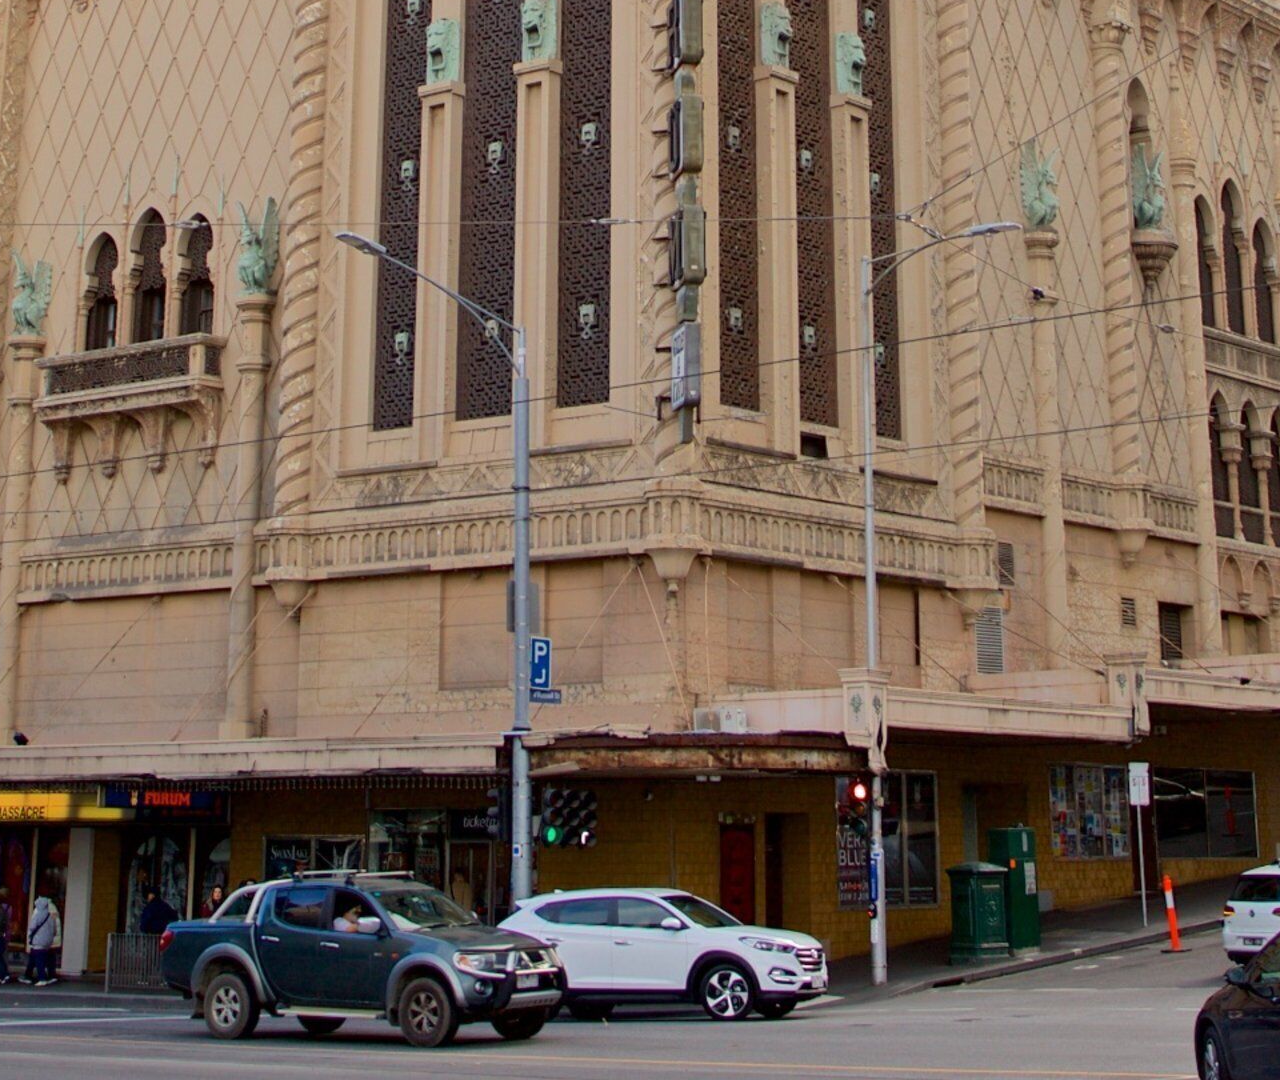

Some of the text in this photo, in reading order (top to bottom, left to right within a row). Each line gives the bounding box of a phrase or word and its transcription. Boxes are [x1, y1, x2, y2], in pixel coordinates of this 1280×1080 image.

[534, 641, 548, 664] P
[144, 791, 191, 807] FORUM
[838, 849, 867, 866] BLUE
